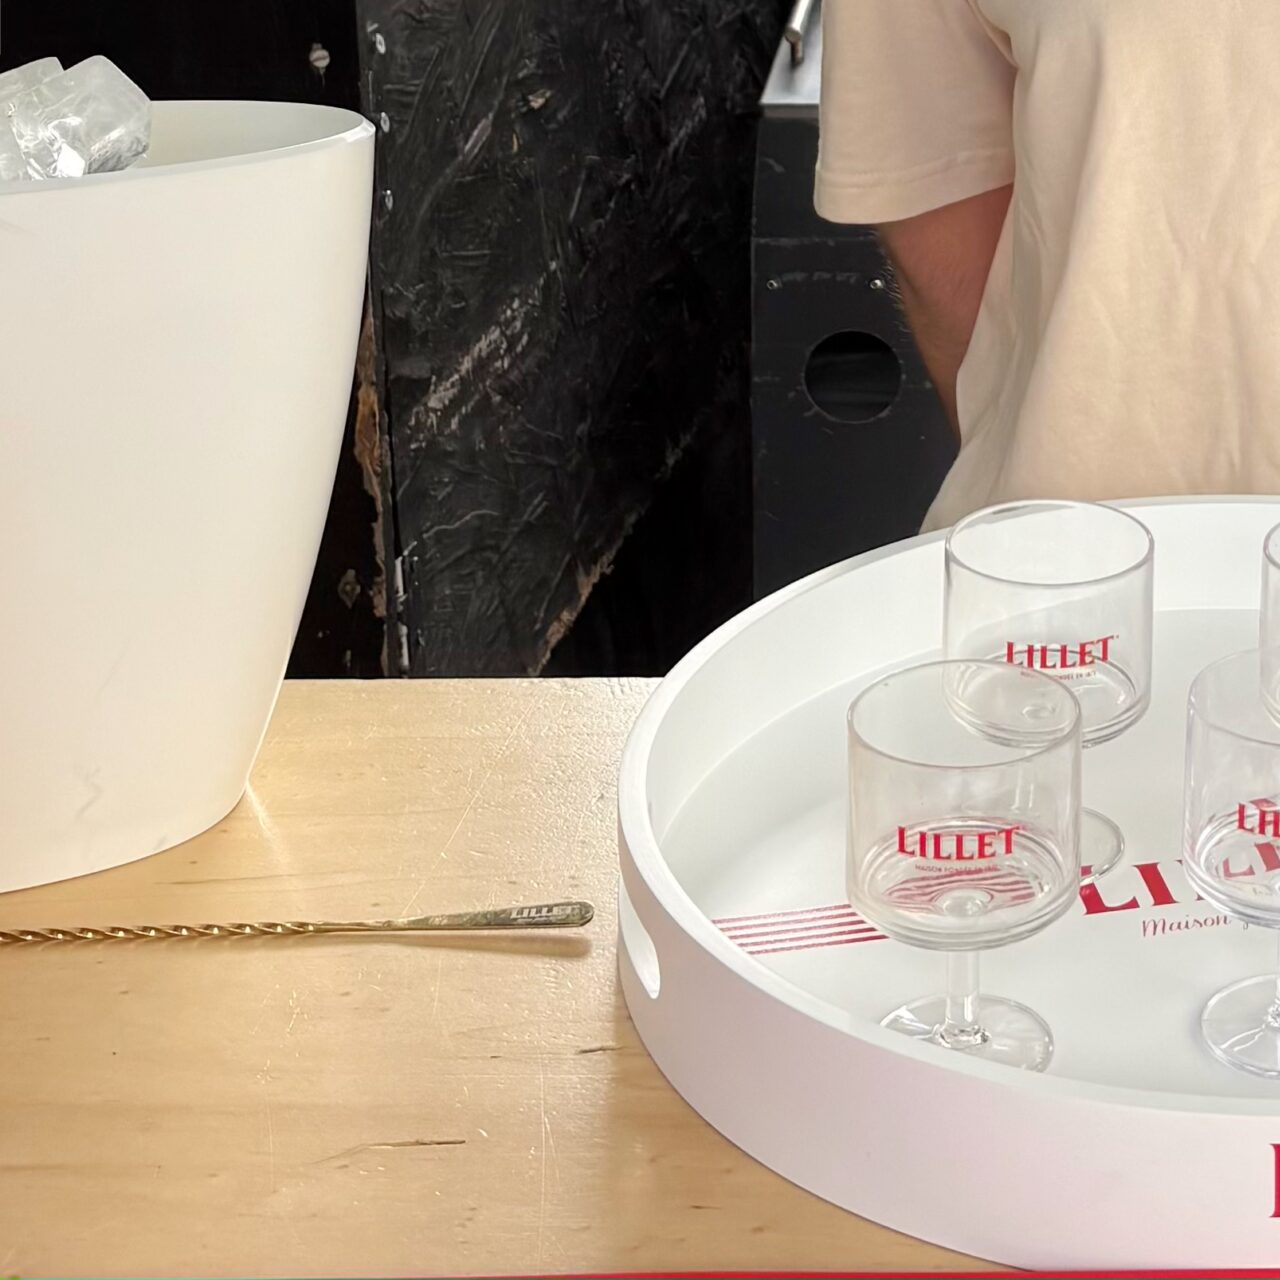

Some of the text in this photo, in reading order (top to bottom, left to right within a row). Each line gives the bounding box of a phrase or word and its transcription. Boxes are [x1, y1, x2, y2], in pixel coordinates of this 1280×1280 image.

[1007, 634, 1115, 670] LILLET
[898, 825, 1020, 861] LILLET
[1142, 914, 1233, 938] Maison
